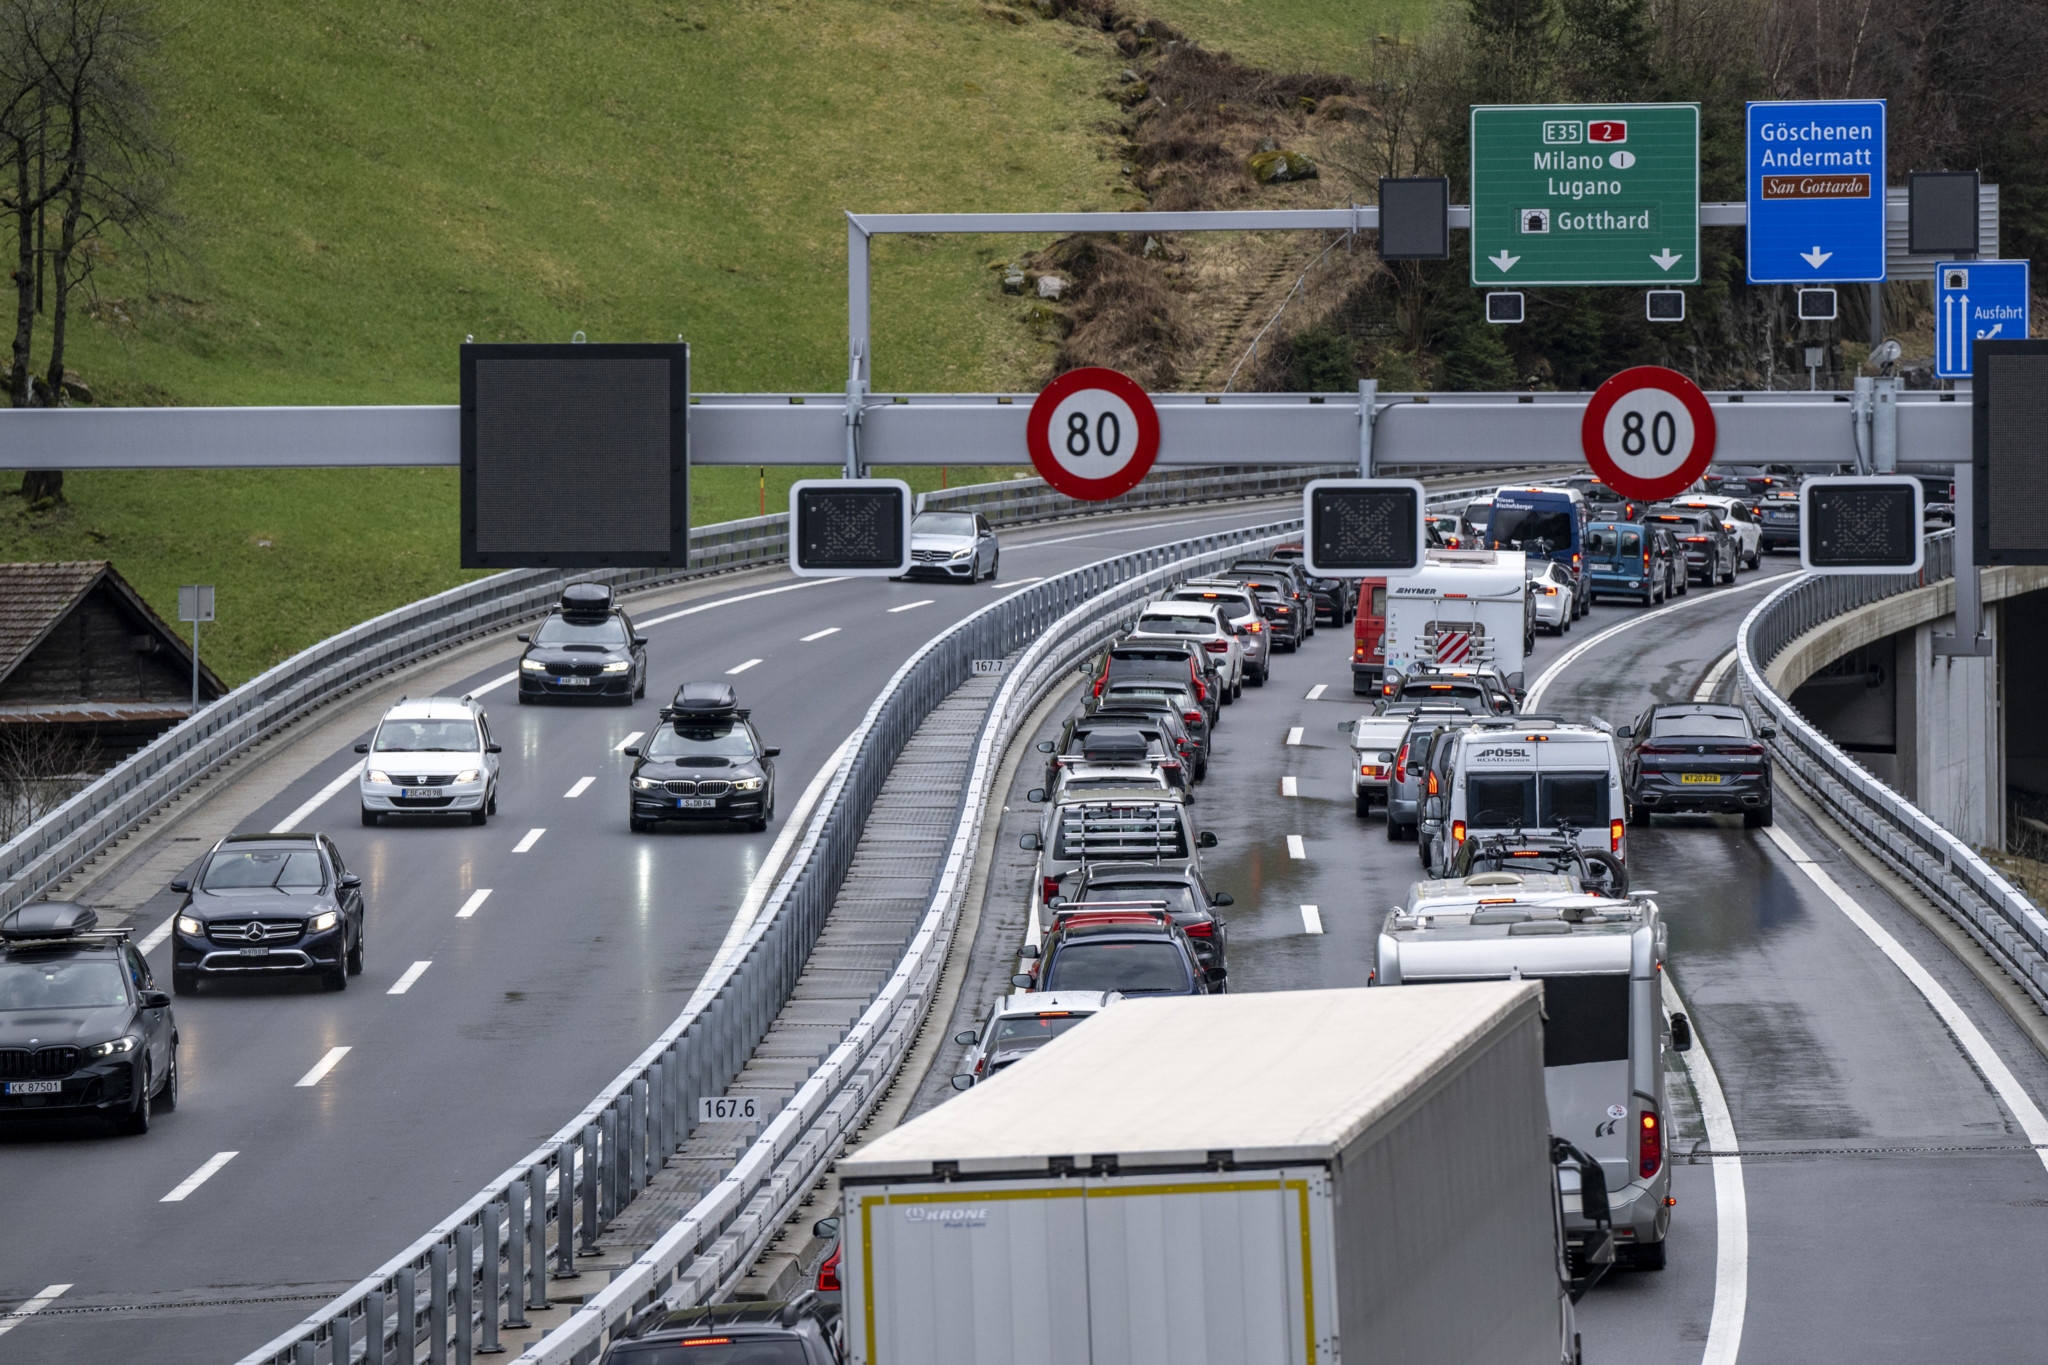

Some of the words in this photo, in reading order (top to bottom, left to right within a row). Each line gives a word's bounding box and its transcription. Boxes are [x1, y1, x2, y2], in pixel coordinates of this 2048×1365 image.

[1547, 124, 1577, 140] E35
[1603, 124, 1612, 139] 2
[1760, 121, 1872, 141] Göschenen
[1533, 151, 1603, 170] Milano
[1761, 147, 1871, 167] Andermatt
[1548, 177, 1621, 200] Lugano
[1767, 178, 1795, 194] San
[1800, 177, 1863, 194] Gottardo
[1557, 209, 1649, 230] Gotthard
[1974, 305, 2023, 320] Ausfahrt
[1066, 411, 1120, 457] 80
[1621, 410, 1676, 456] 80
[1403, 587, 1437, 595] HYMER
[975, 660, 1003, 672] 167.7
[1486, 747, 1530, 757] PÖSSL
[406, 789, 419, 797] EBE
[11, 1083, 25, 1093] KK
[28, 1082, 58, 1092] 87501
[705, 1099, 755, 1119] 167.6
[925, 1208, 990, 1221] KRONE
